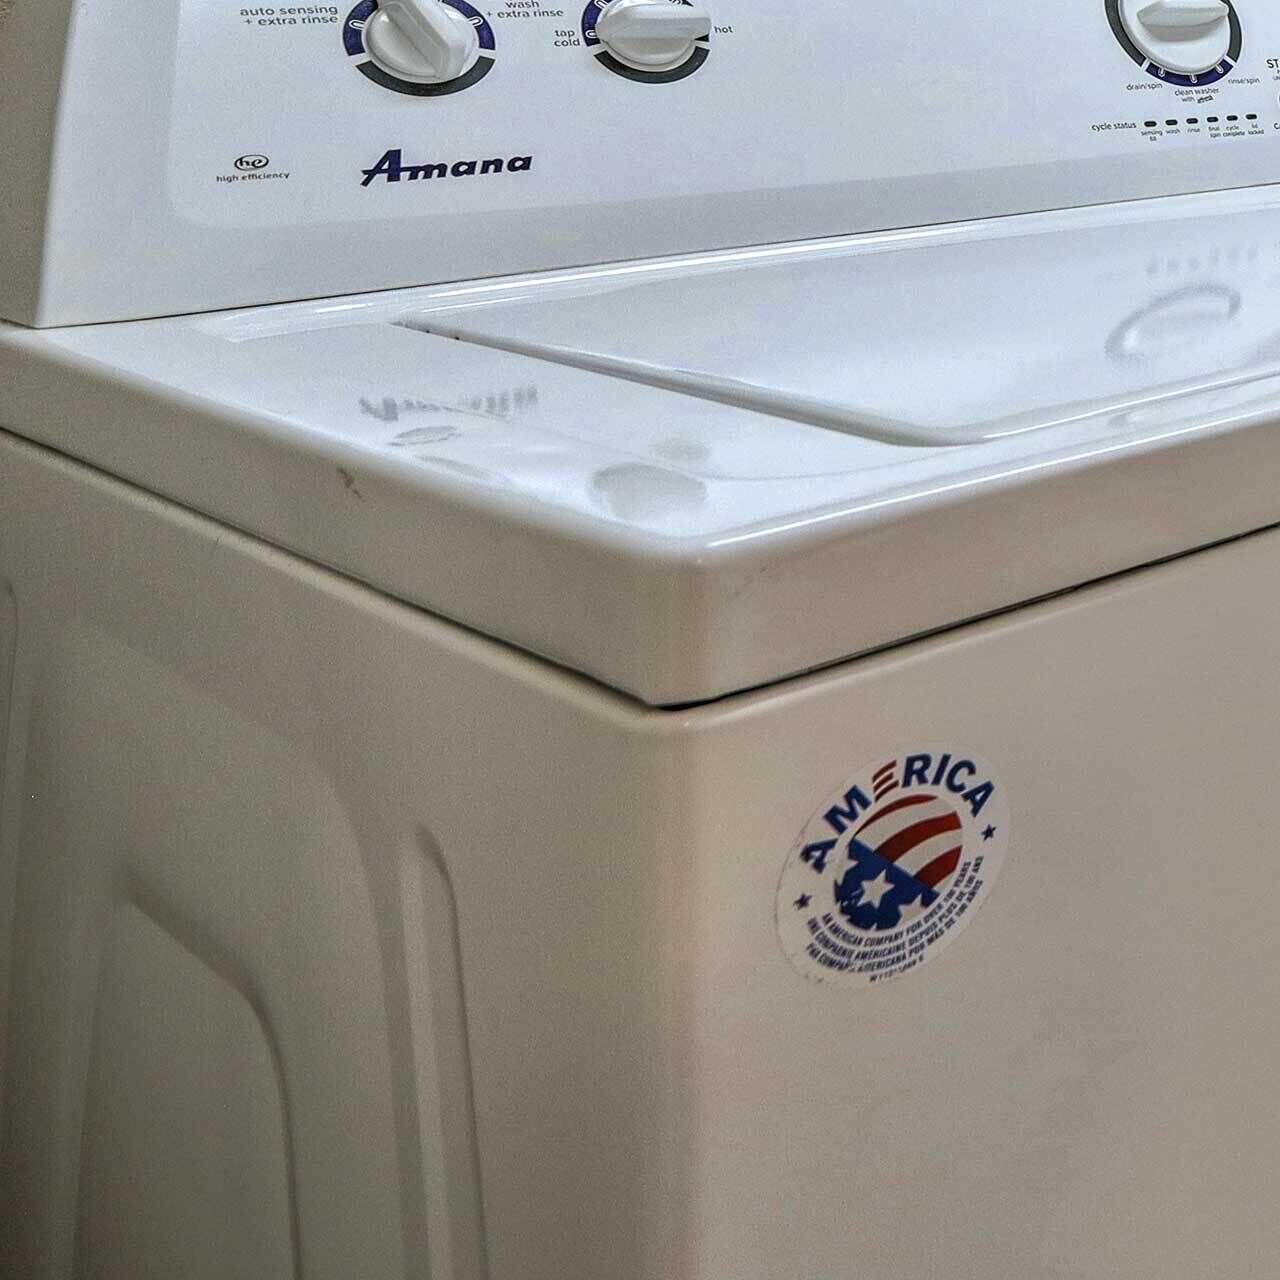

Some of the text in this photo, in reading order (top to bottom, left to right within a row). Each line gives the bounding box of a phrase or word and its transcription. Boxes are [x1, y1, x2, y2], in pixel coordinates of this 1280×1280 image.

[505, 0, 540, 8] wash
[240, 5, 338, 16] auto sensing
[497, 9, 530, 18] extra
[533, 9, 564, 17] rinse
[258, 16, 297, 26] extra
[302, 15, 338, 24] rinse
[555, 29, 575, 38] tap
[714, 25, 733, 34] hot
[554, 38, 581, 47] cold
[1126, 82, 1163, 91] drain/spin
[1091, 121, 1137, 131] cycle status
[360, 149, 533, 187] Amana
[216, 172, 290, 184] high efficiency
[800, 753, 995, 874] AMERICA
[829, 923, 866, 946] AMERICAN
[864, 928, 905, 947] COMPANY
[906, 918, 922, 936] FOR
[923, 903, 944, 924] OVER
